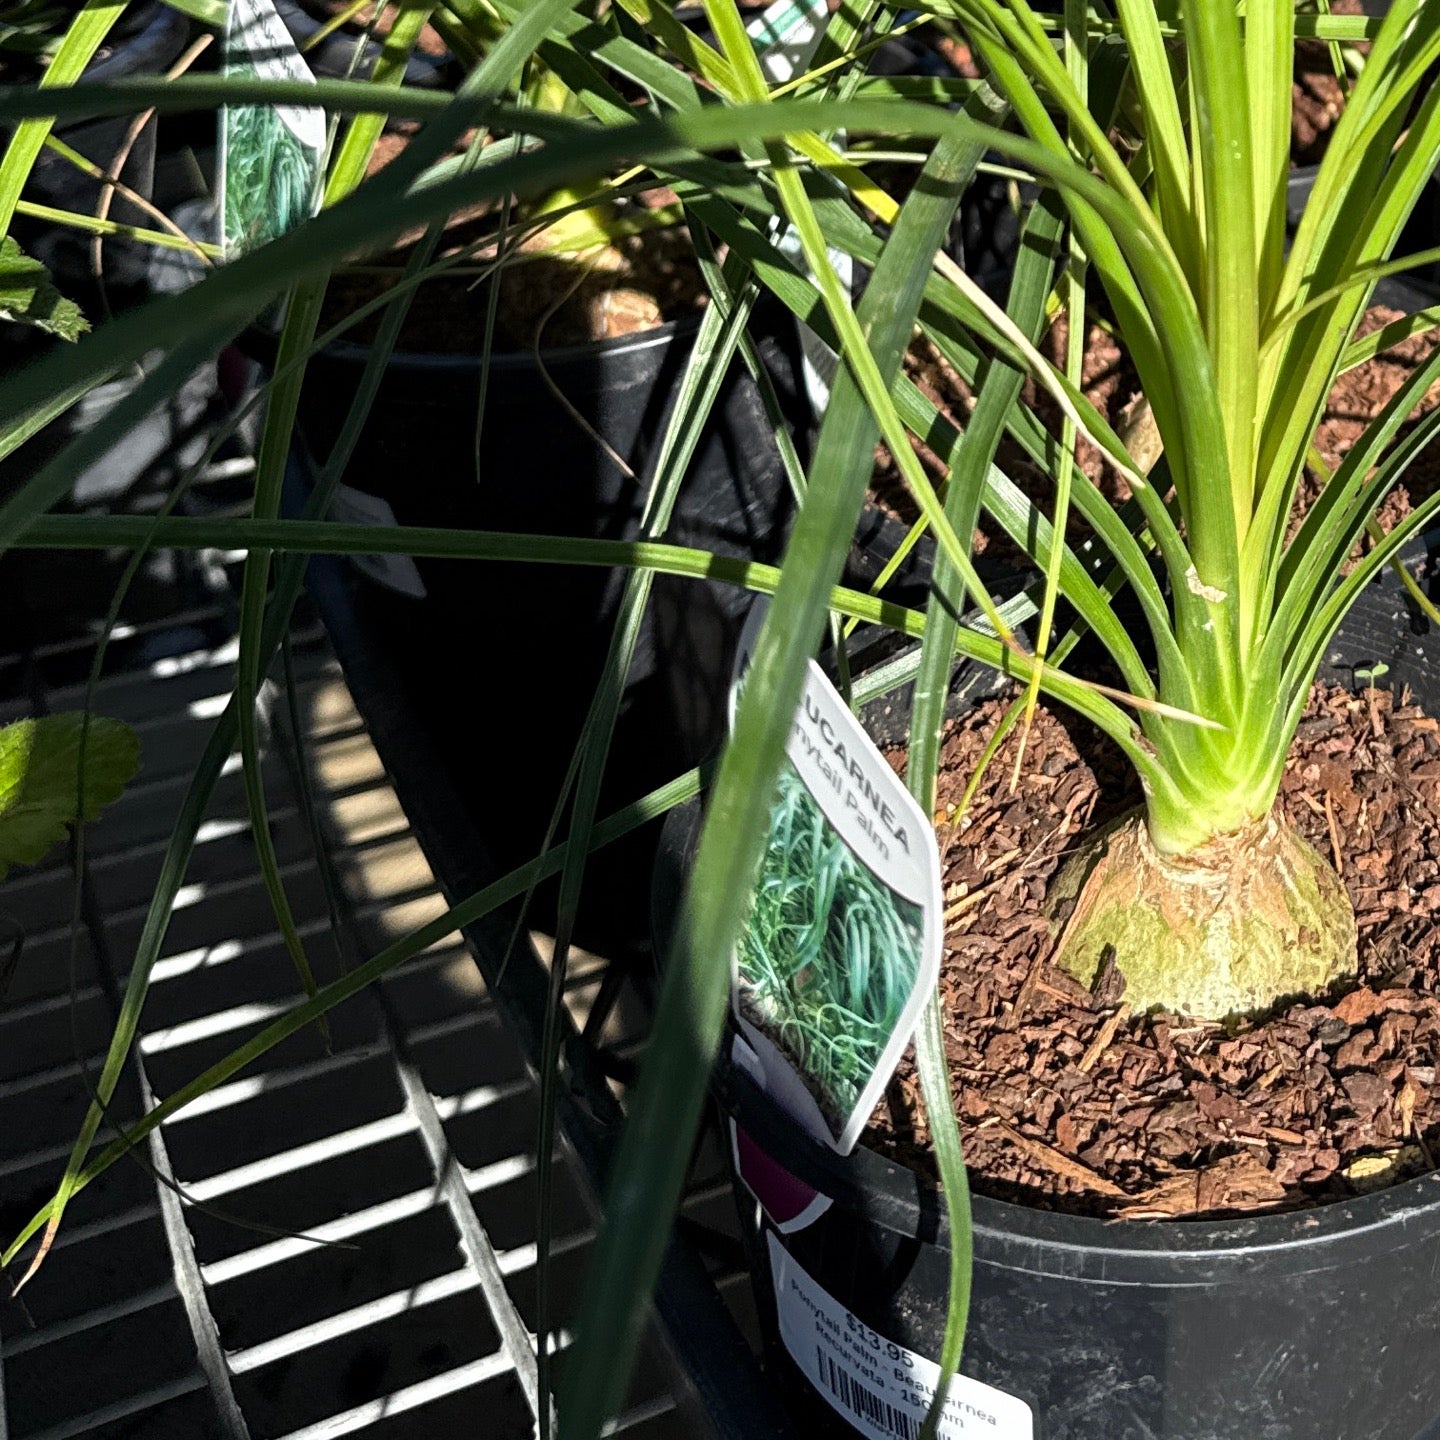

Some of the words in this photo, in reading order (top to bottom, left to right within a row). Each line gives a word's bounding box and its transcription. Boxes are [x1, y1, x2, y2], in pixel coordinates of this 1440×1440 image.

[796, 723, 843, 795] nytail
[845, 789, 889, 860] Palm
[806, 694, 910, 854] UCARNEA
[791, 1278, 840, 1336] Ponytail
[843, 1333, 878, 1368] Palm
[893, 1367, 997, 1426] Beauarnea
[815, 1321, 885, 1387] Recurvata
[846, 1312, 915, 1369] $13.95
